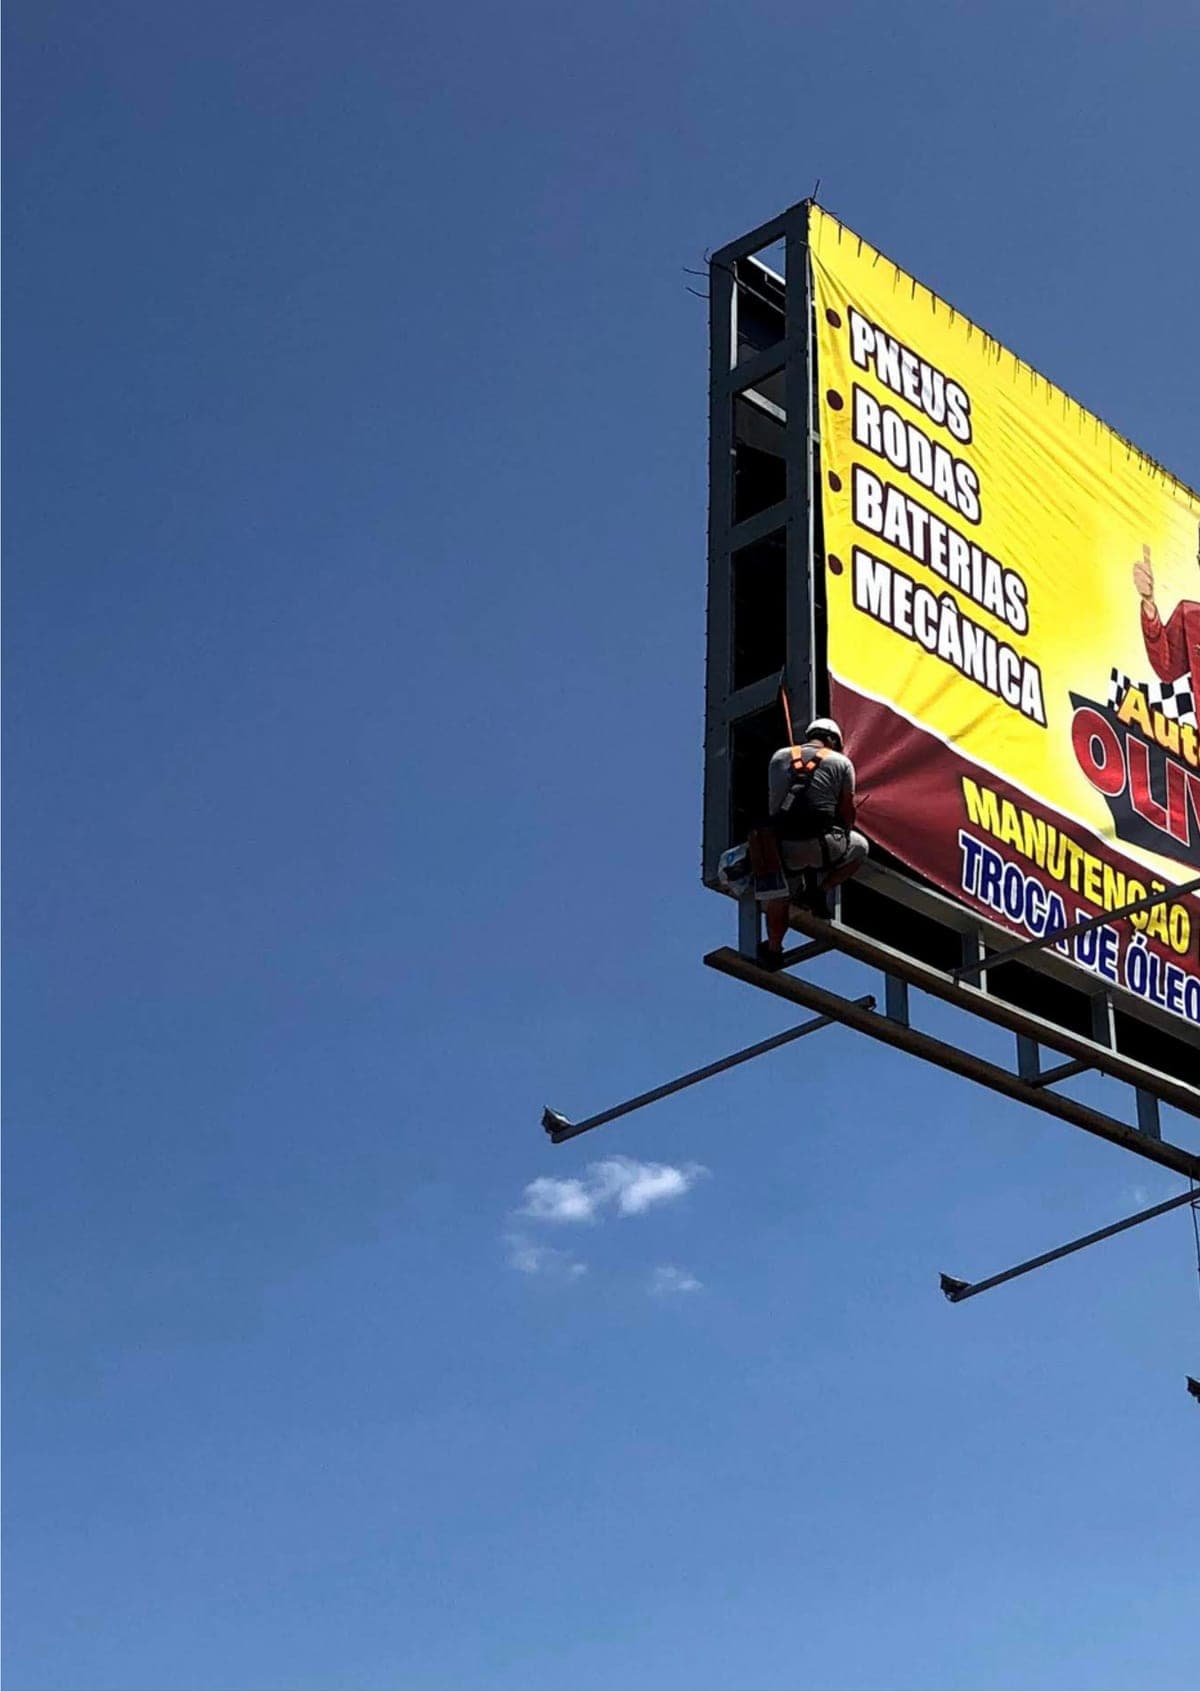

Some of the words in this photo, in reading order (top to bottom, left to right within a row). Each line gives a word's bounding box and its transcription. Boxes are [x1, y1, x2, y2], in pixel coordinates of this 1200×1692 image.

[847, 306, 972, 444] PNEUS
[852, 382, 982, 524] RODAS
[851, 462, 1029, 636] BATERIAS
[851, 545, 1048, 728] MECÂNICA
[958, 829, 1069, 955] TROCA
[1074, 908, 1119, 984] DE
[963, 776, 1190, 954] MANUTENÇÃO
